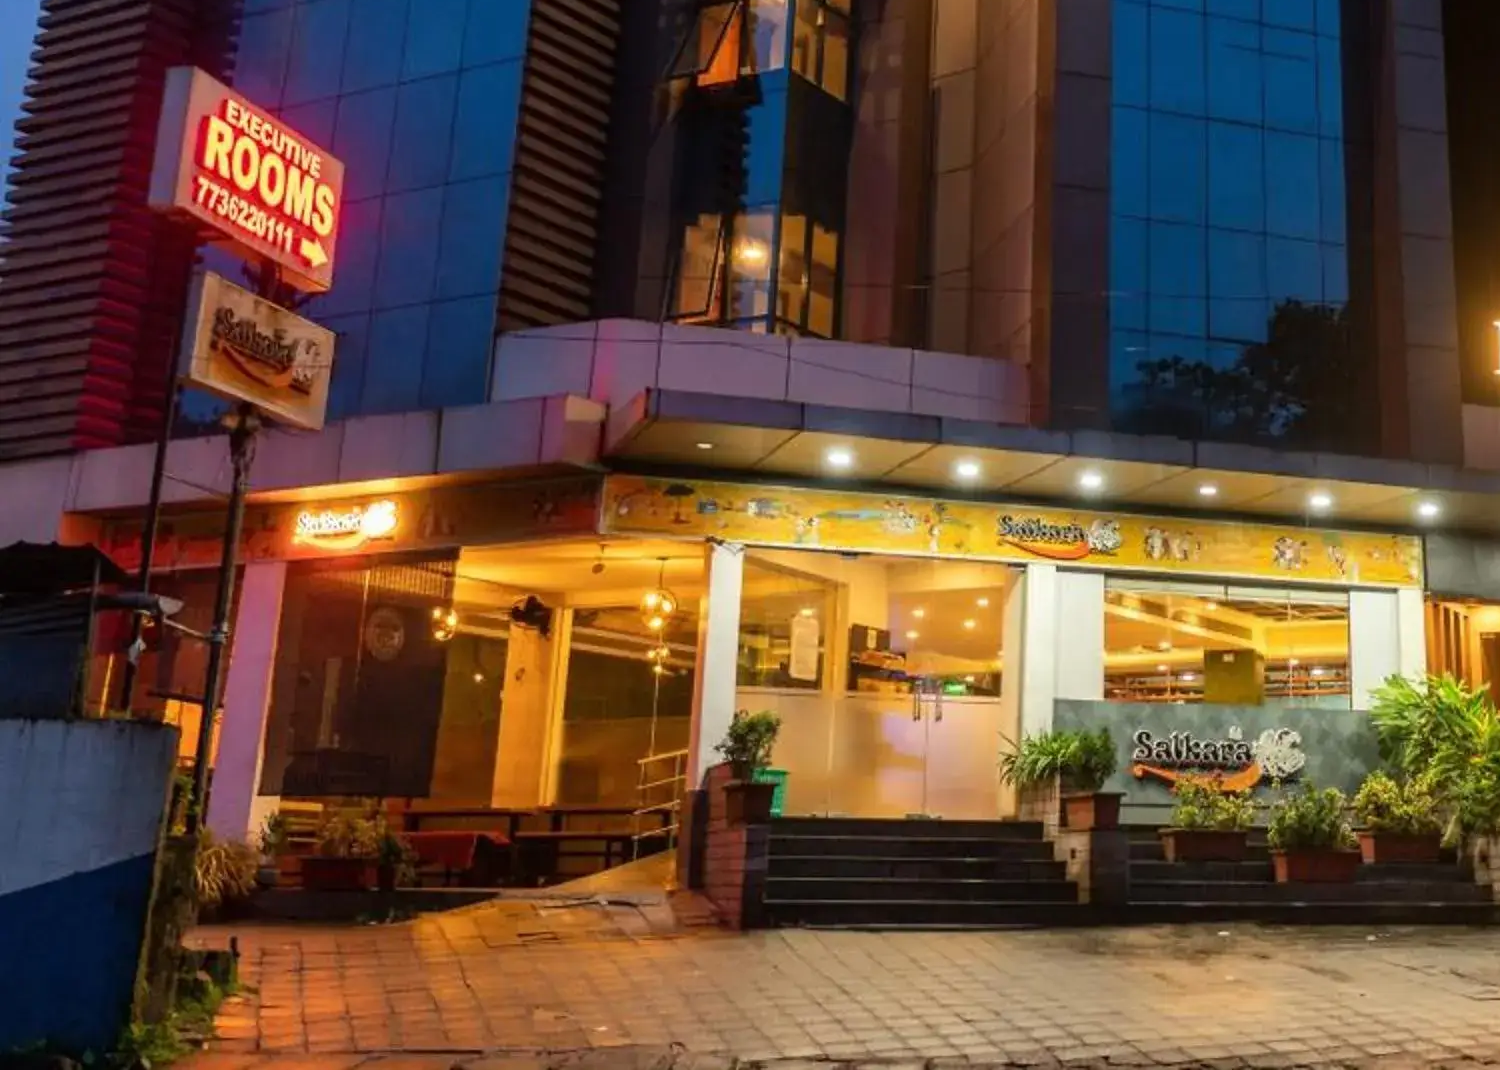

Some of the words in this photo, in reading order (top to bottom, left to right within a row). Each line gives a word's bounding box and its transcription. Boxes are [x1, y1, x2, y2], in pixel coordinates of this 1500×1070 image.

[204, 114, 336, 237] ROOMS
[225, 98, 321, 179] EXECUTIVE
[197, 177, 294, 254] 7736220111
